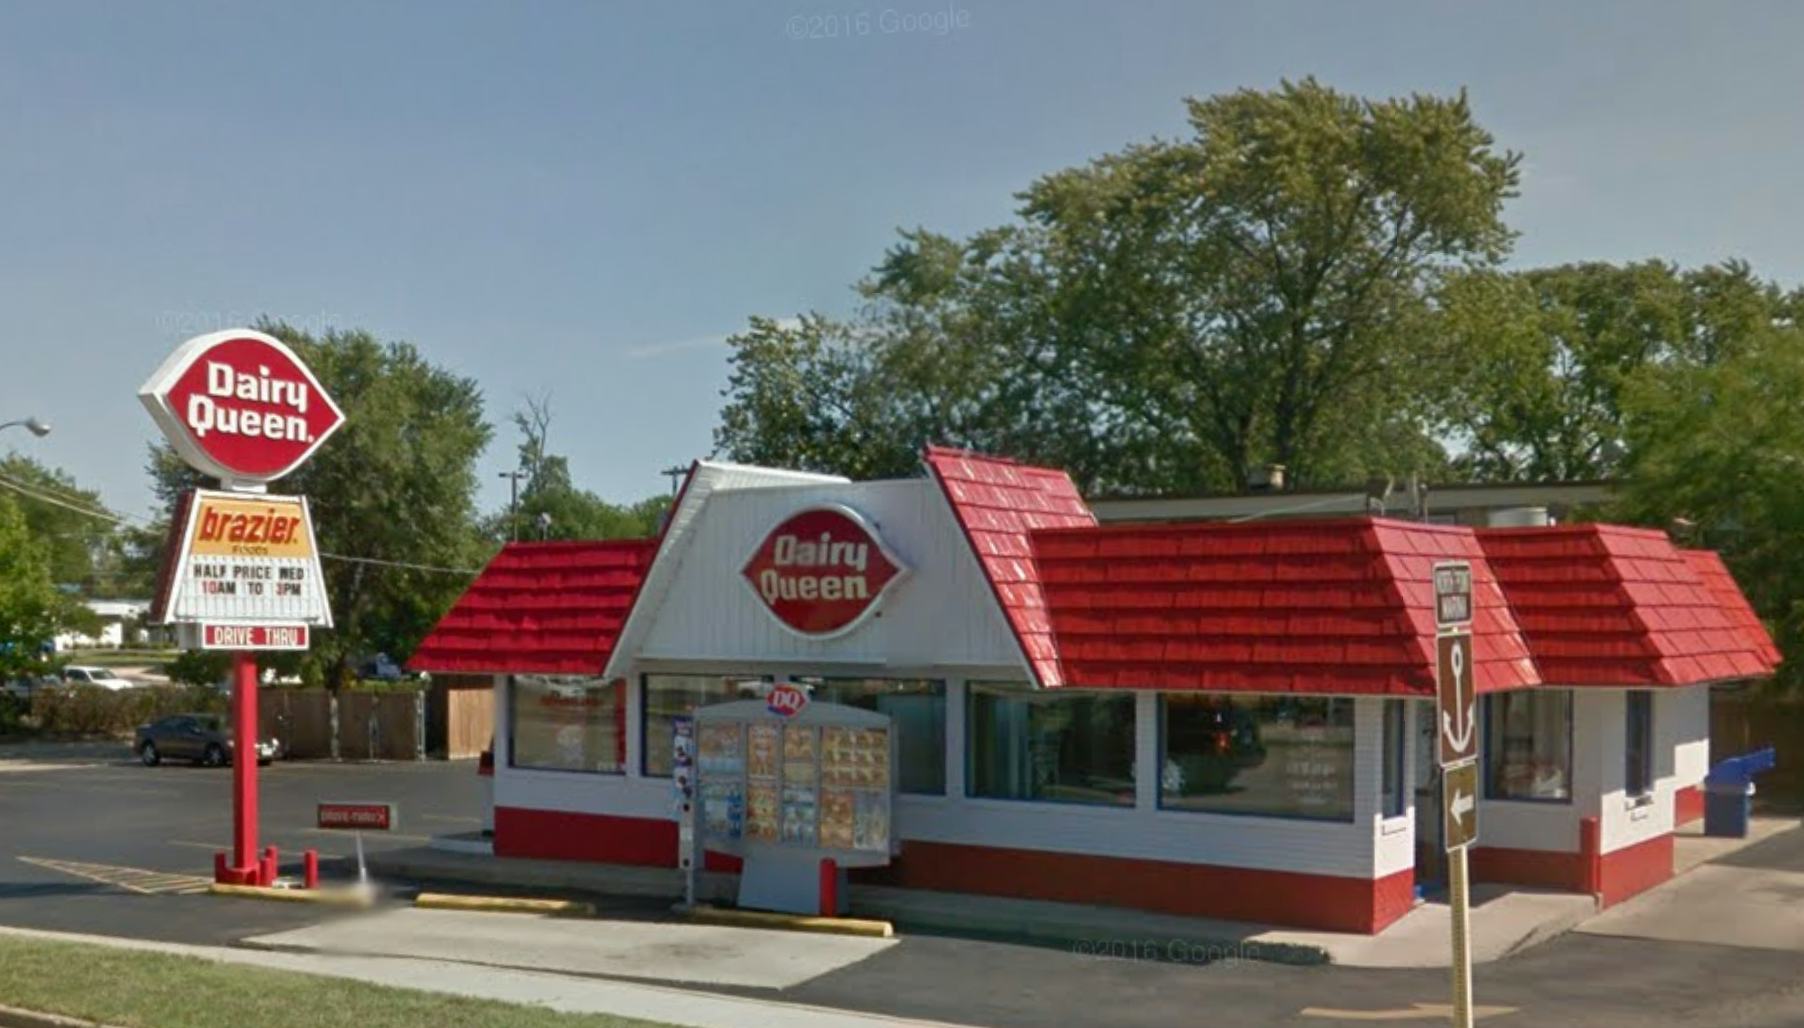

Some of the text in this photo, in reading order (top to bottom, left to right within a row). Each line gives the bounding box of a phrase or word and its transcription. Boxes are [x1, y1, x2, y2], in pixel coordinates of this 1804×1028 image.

[207, 359, 308, 413] Dairy
[774, 531, 868, 572] Dairy
[194, 565, 304, 580] HALF PRICE WED
[203, 581, 302, 596] 10AM TO 3PM
[759, 569, 868, 606] Queen
[214, 627, 298, 645] DRIVE THRU
[772, 690, 800, 706] DQ
